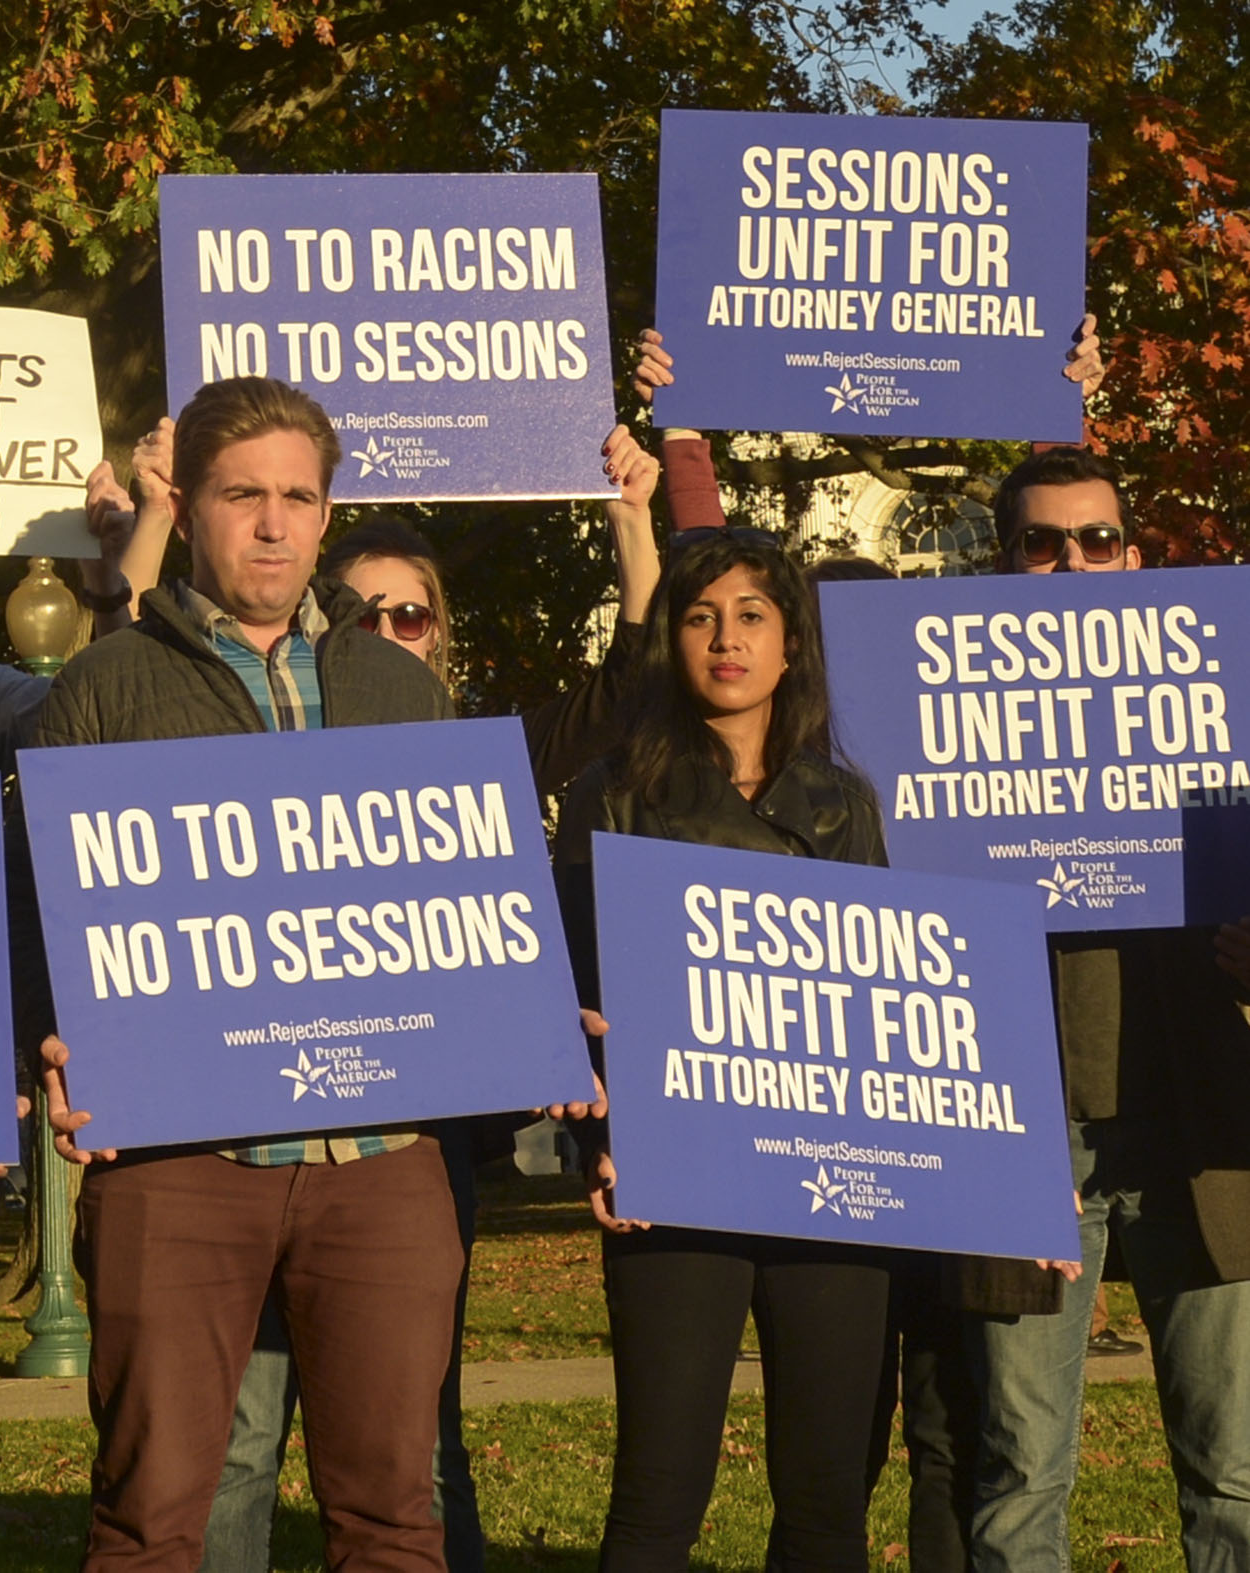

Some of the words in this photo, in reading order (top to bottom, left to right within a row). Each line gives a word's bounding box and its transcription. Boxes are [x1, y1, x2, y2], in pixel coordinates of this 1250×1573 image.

[741, 145, 1009, 217] SESSIONS:
[197, 228, 271, 294] NO
[284, 228, 355, 293] TO
[370, 226, 577, 292] RACISM
[738, 215, 893, 284] UNFIT
[909, 221, 1009, 288] FOR
[707, 285, 883, 332] ATTORNEY
[891, 291, 1045, 338] GENERAL
[199, 322, 268, 385] NO
[277, 321, 342, 384] TO
[353, 318, 589, 384] SESSIONS
[785, 351, 960, 372] www.RejectSessions.com
[329, 412, 488, 433] w.RejectSessions.com
[914, 605, 1220, 685] SESSIONS:
[918, 687, 1093, 765] UNFIT
[1112, 682, 1231, 757] FOR
[895, 767, 1089, 821] ATTORNEY
[69, 807, 162, 889] NO
[171, 800, 259, 881] TO
[271, 782, 515, 874] RACISM
[85, 921, 171, 1000] NO
[176, 913, 257, 991] TO
[266, 891, 540, 984] SESSIONS
[684, 883, 970, 989] SESSIONS:
[223, 1013, 435, 1047] www.RejectSessions.com
[687, 966, 853, 1059] UNFIT
[870, 986, 982, 1073] FOR
[664, 1048, 850, 1116] ATTORNEY
[860, 1069, 1026, 1134] GENERAL
[753, 1136, 943, 1170] www.RejectSessions.com
